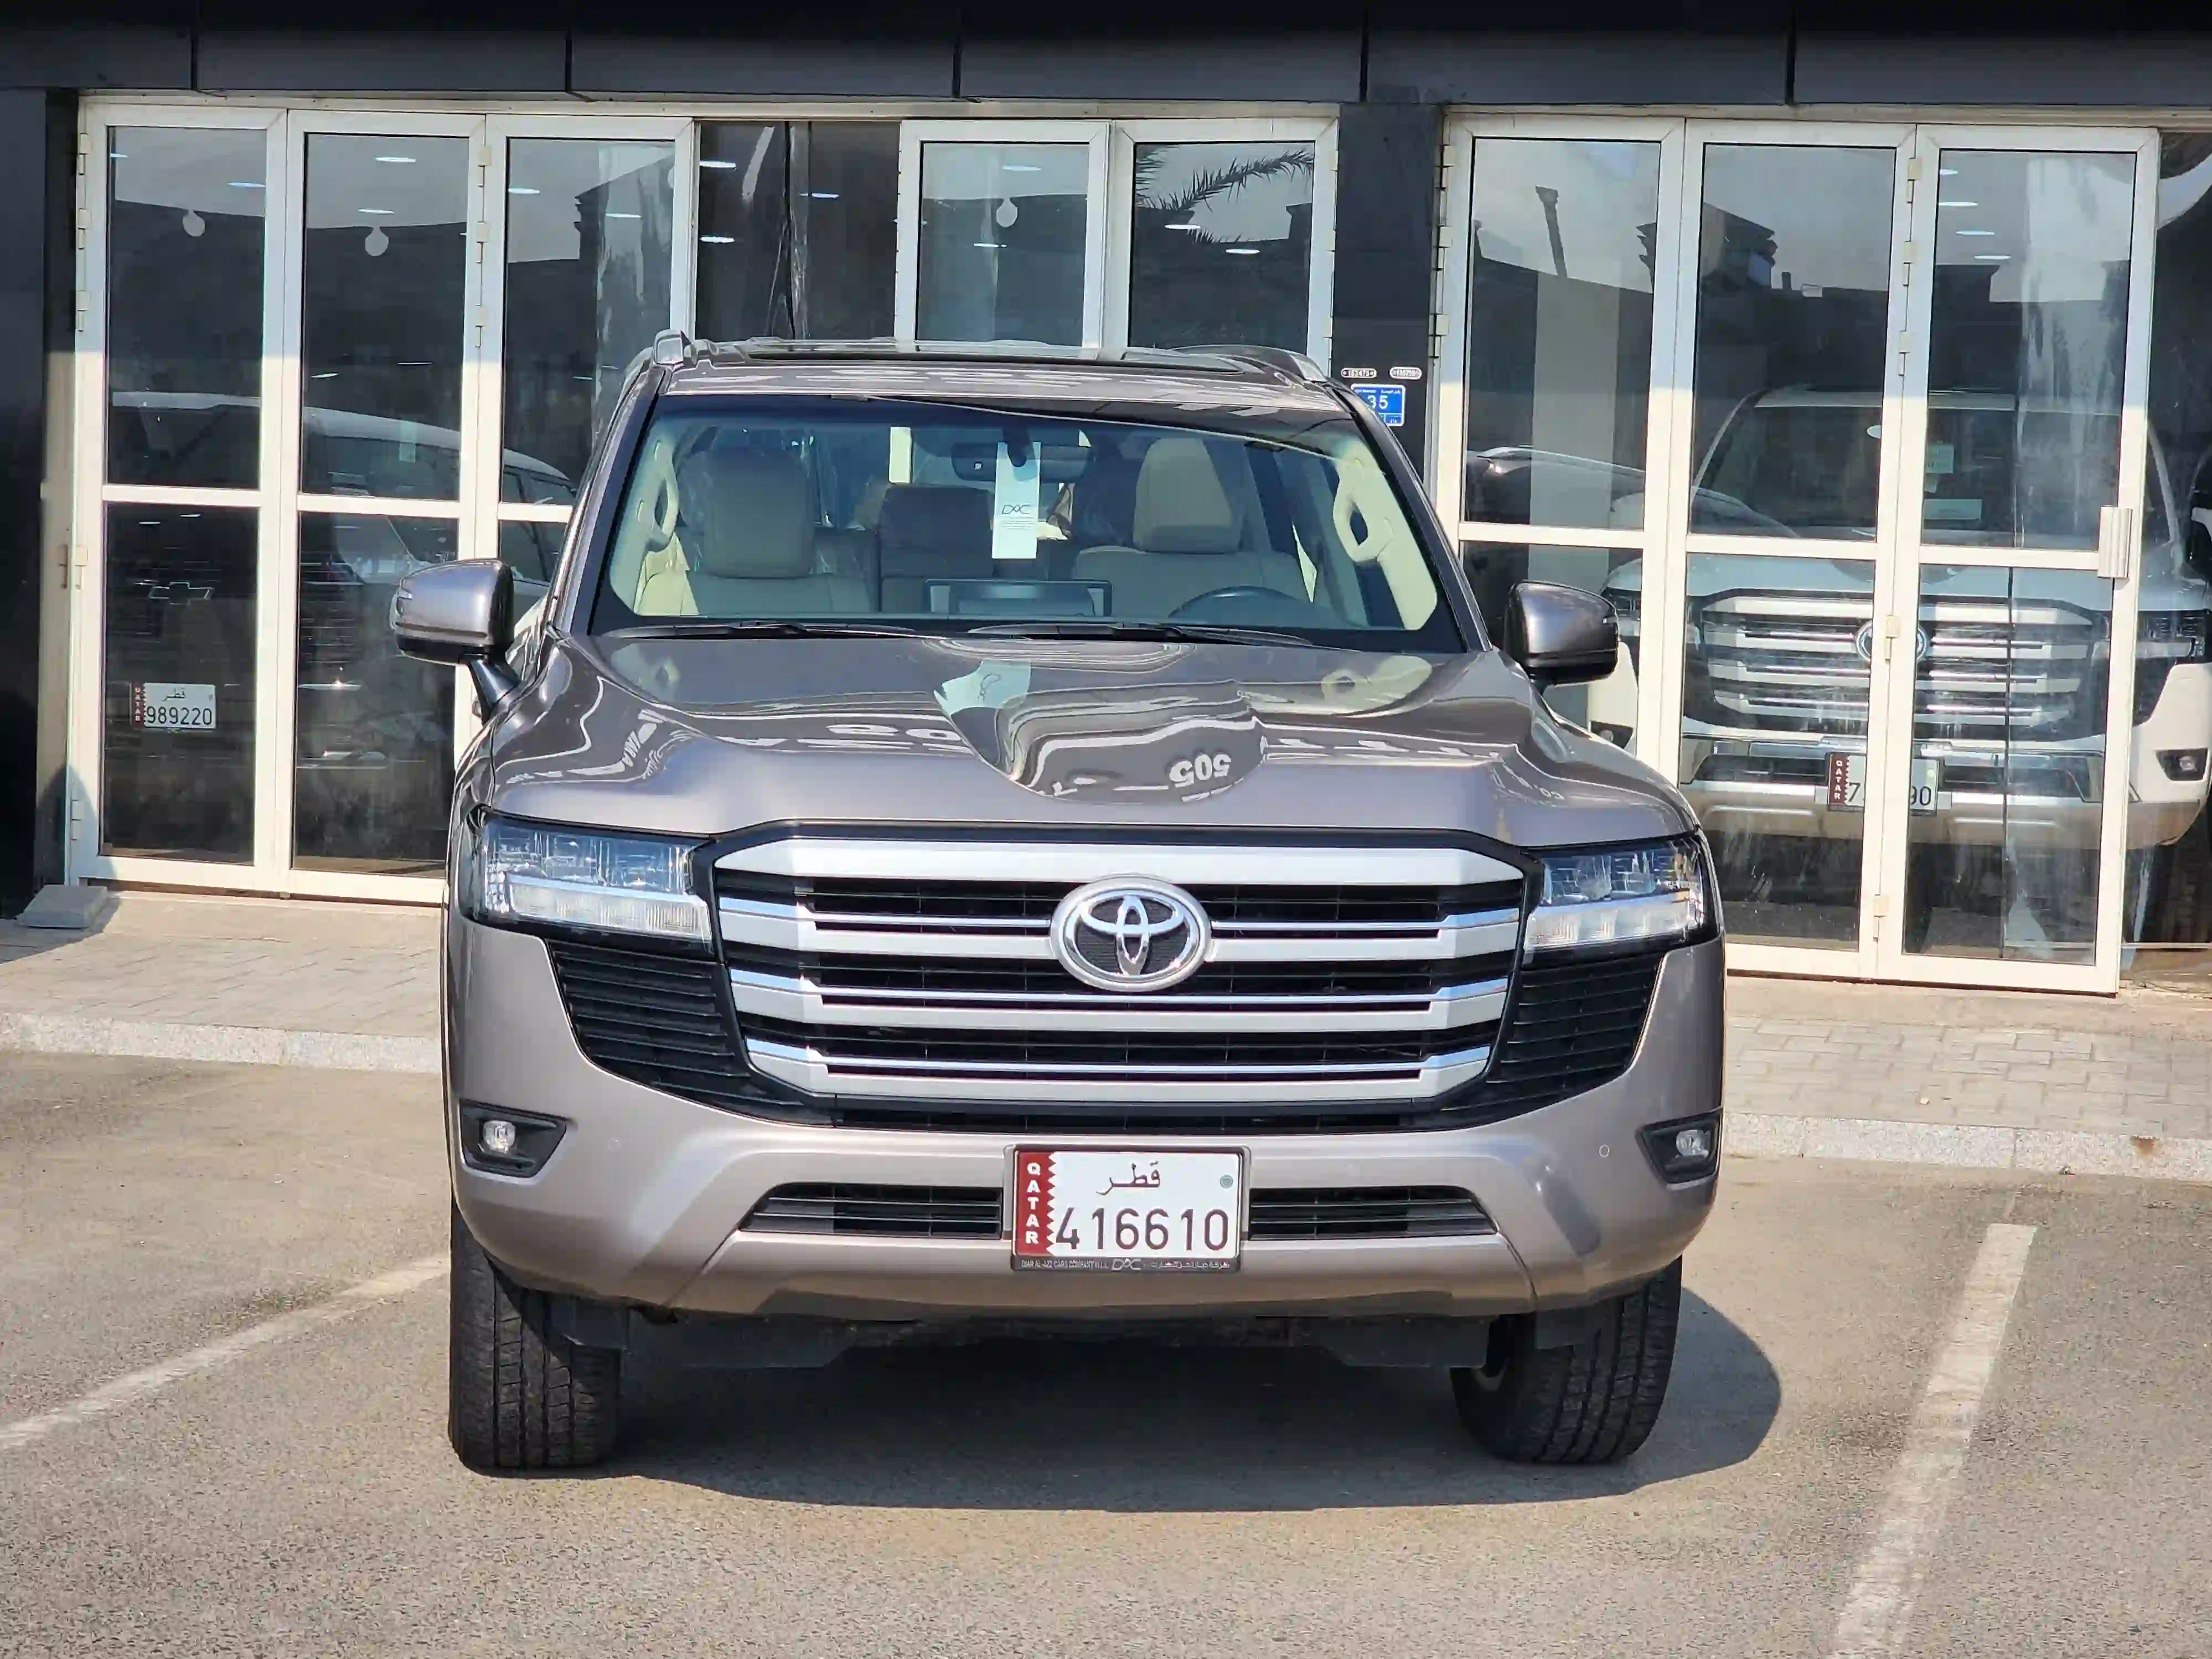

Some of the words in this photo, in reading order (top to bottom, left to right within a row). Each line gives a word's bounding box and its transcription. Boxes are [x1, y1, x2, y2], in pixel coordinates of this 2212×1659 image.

[161, 687, 186, 701] قطر
[147, 706, 212, 726] 989220
[1834, 760, 1843, 800] QATAR
[1096, 1160, 1160, 1195] قطر
[1026, 1162, 1041, 1244] QATAR
[1056, 1207, 1229, 1251] 416610
